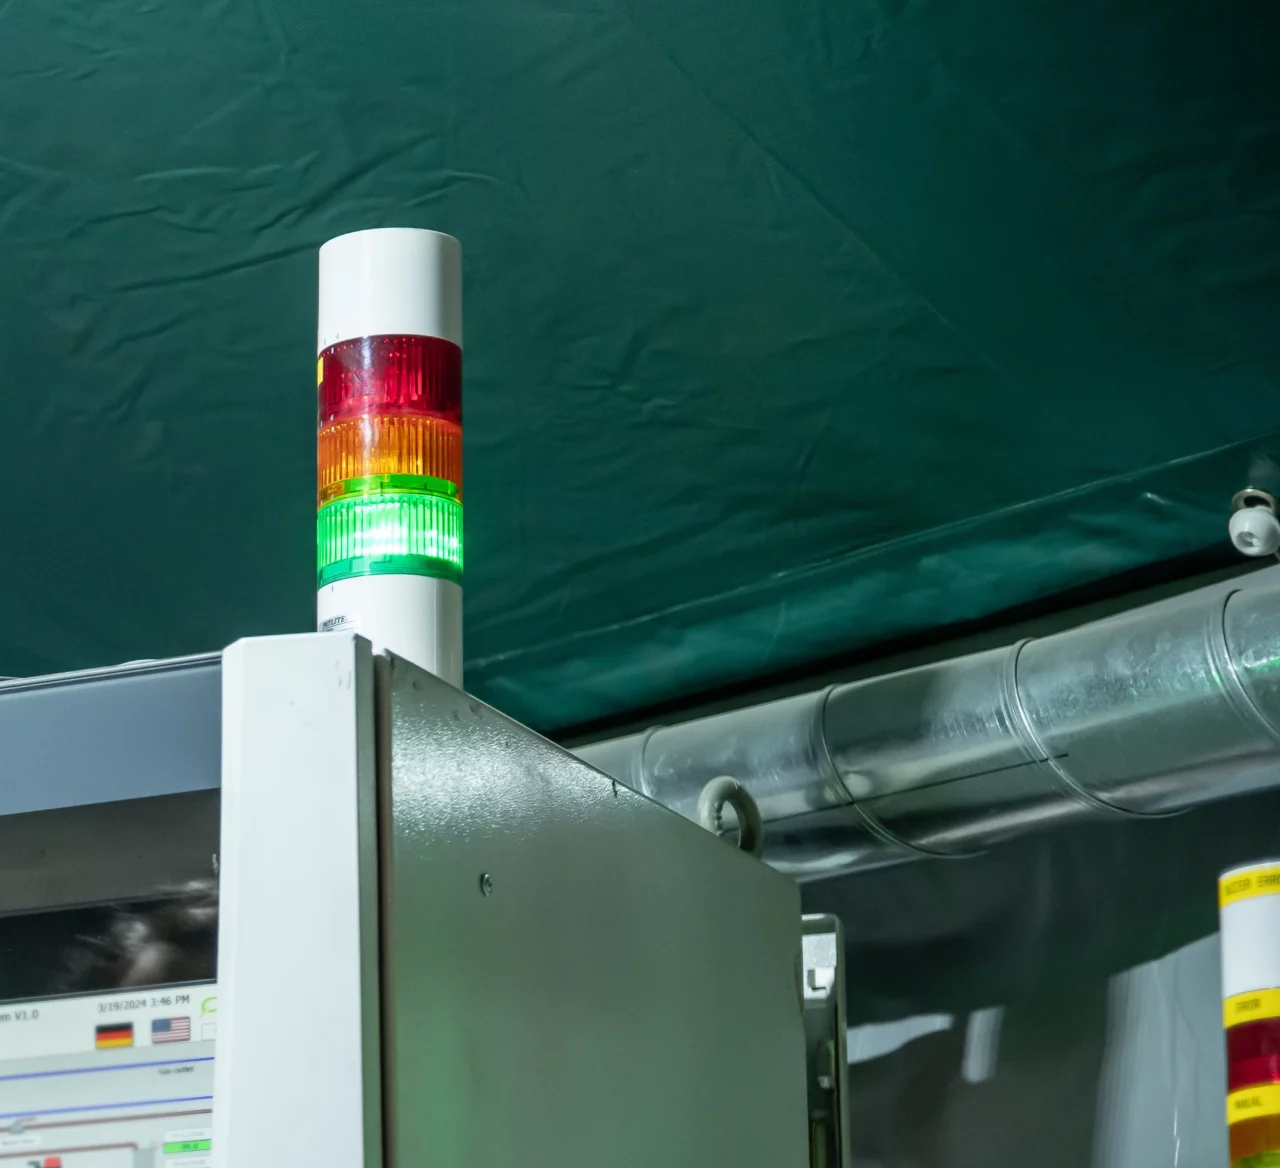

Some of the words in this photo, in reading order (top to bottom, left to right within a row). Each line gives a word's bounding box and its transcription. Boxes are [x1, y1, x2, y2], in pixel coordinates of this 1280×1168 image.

[97, 998, 147, 1014] 3/19/2024
[149, 995, 172, 1008] 3:46
[175, 993, 190, 1005] PM
[14, 1008, 40, 1021] V1.0
